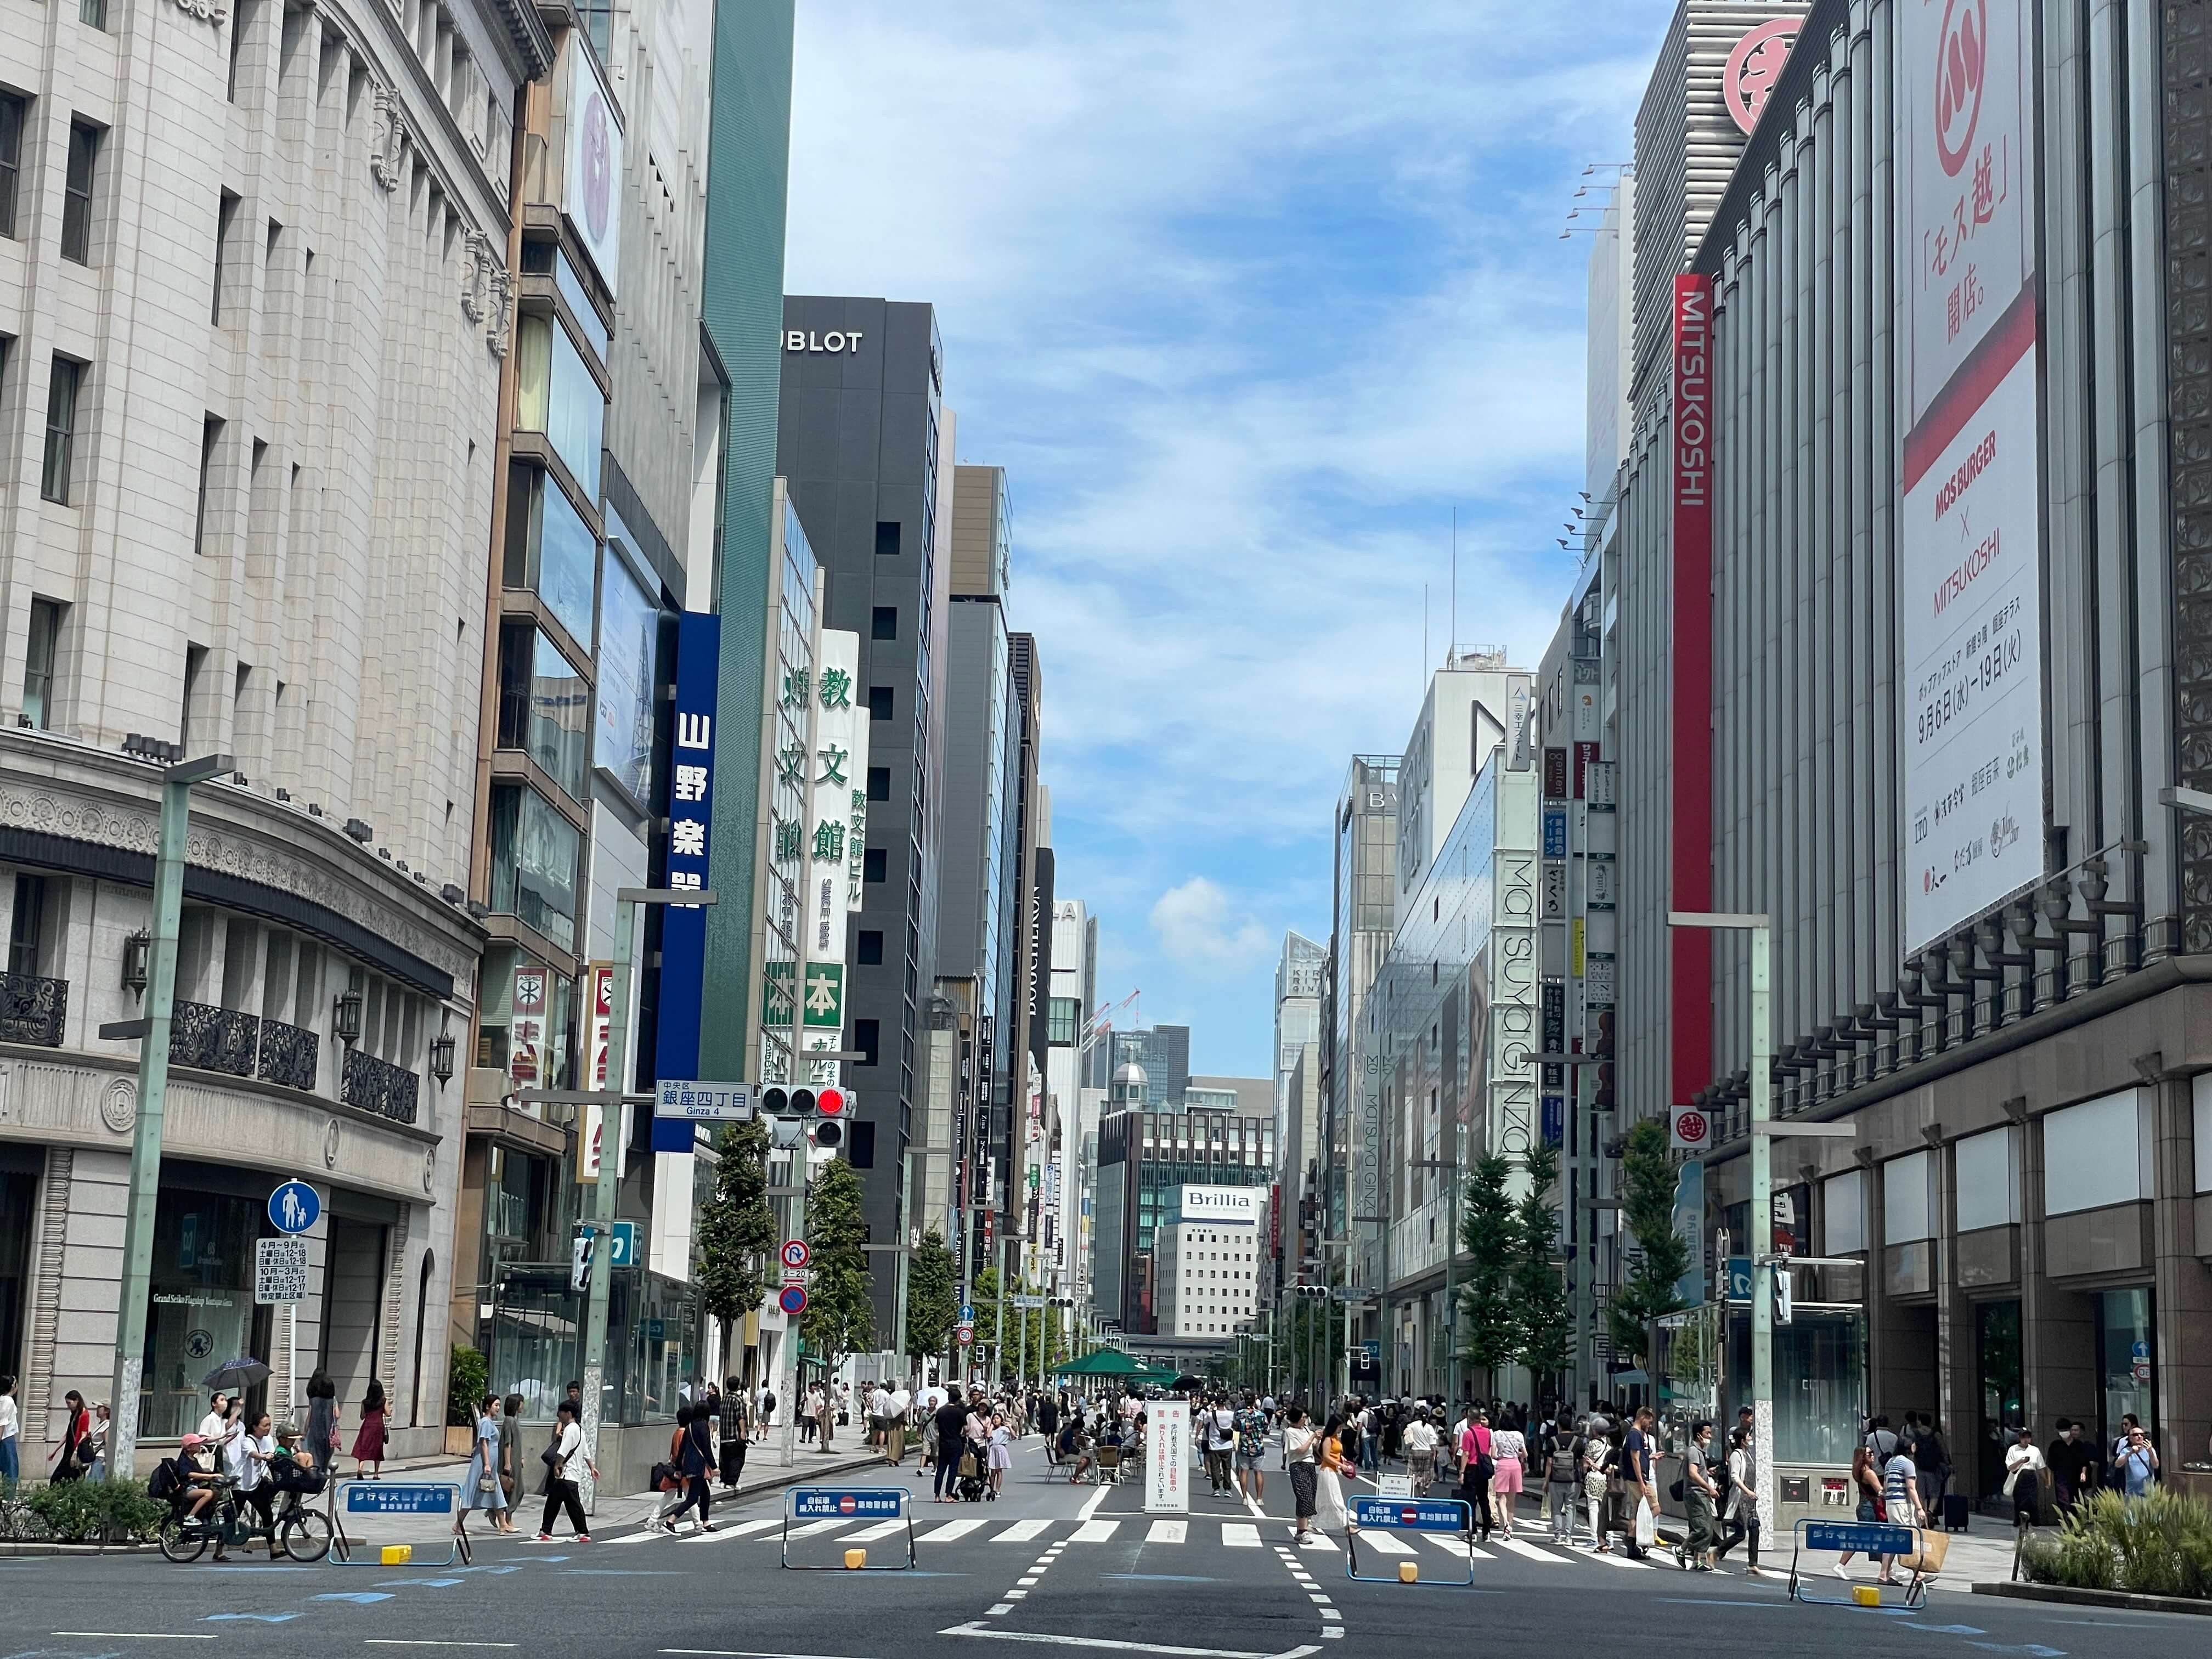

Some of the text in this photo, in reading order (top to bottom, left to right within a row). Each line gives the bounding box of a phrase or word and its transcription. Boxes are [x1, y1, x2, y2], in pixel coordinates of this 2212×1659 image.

[1924, 134, 2007, 291] 「モス越」
[1948, 263, 1984, 346] 開店。
[781, 330, 864, 353] BLOT
[1680, 291, 1705, 505] MITSUKOSHI
[1935, 430, 1996, 522] MOS BURGER
[1933, 527, 2000, 618] MITSUKOSHI
[1514, 704, 1523, 761] 三幸エステート
[812, 666, 851, 861] 教文館
[848, 788, 867, 899] 教文館ビル
[1546, 819, 1554, 854] イーオン
[820, 878, 832, 947] SINCE 1885
[805, 972, 838, 1017] 本
[827, 1035, 837, 1087] 子どの本の
[662, 1090, 746, 1108] 銀座四丁目
[686, 1107, 710, 1115] Ginza
[1189, 1192, 1250, 1207] Brillia
[154, 1294, 171, 1303] Grand
[171, 1294, 185, 1304] Seiko
[1368, 1505, 1391, 1514] 自転車
